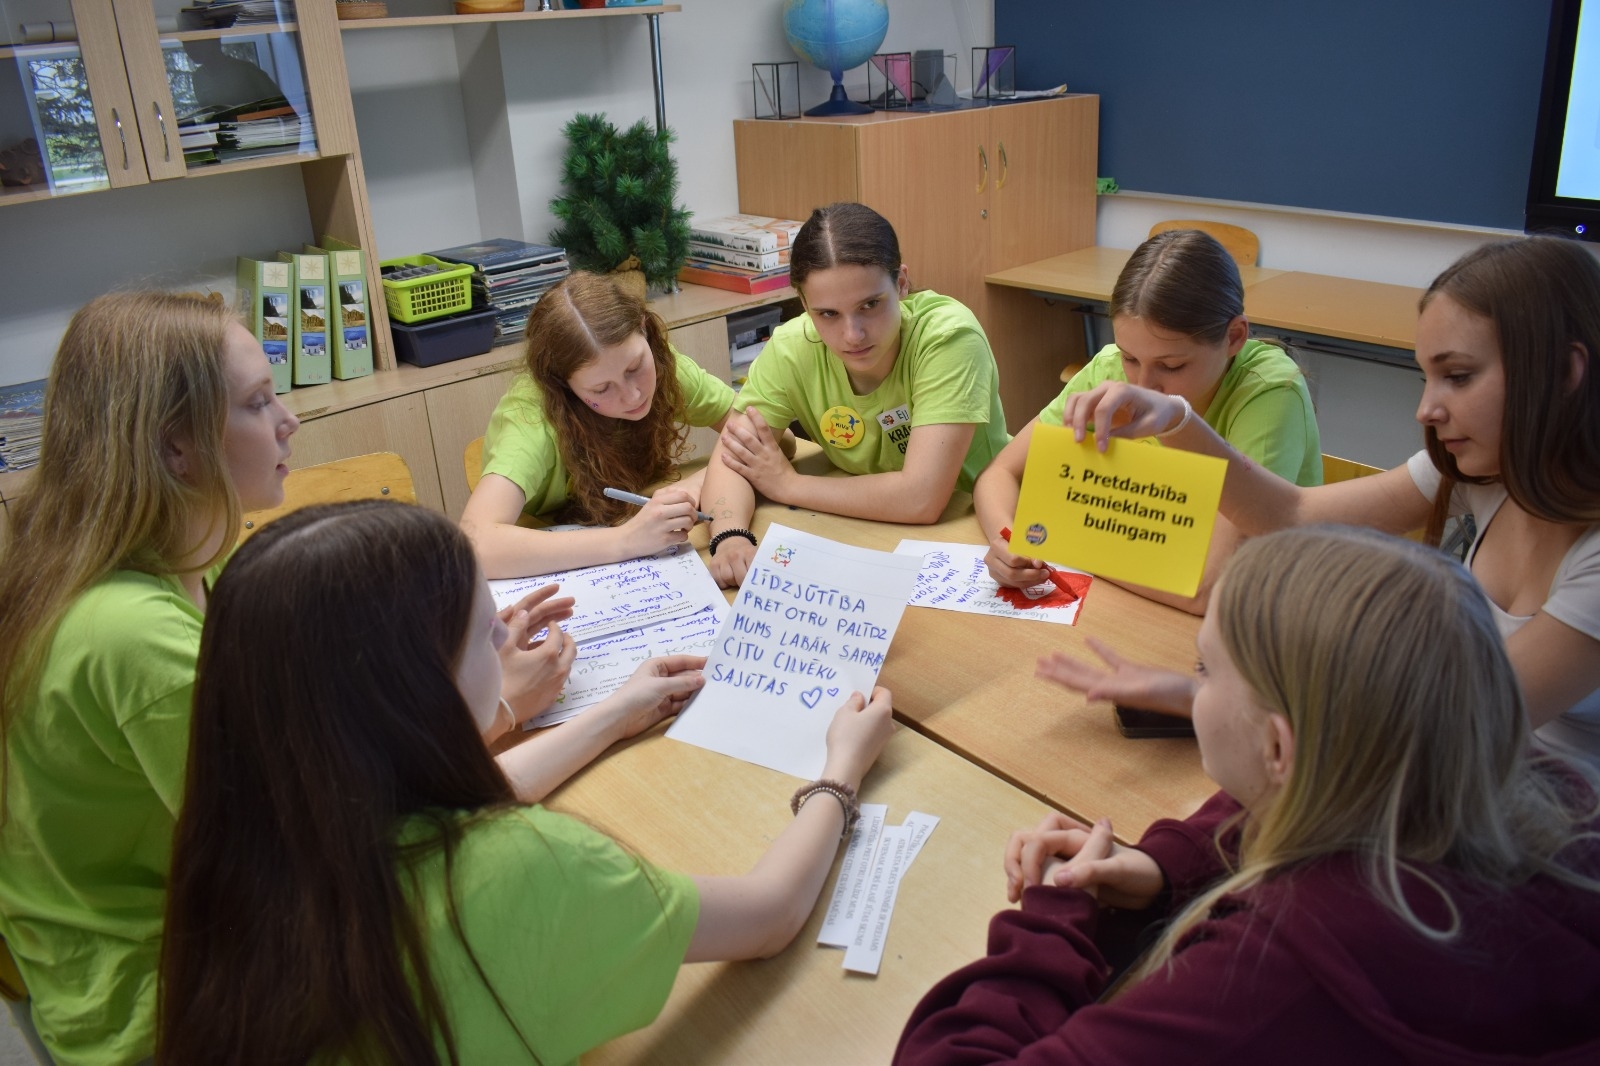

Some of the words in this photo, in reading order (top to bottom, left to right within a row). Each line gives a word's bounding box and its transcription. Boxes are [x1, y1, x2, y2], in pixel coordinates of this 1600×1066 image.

[1059, 464, 1075, 480] 3.
[1082, 468, 1188, 505] Pretdarbība
[1066, 486, 1166, 523] izsmieklam
[1171, 512, 1195, 529] un
[1083, 512, 1167, 546] bulingam
[733, 612, 772, 639] MUMS
[779, 630, 831, 656] LABĀK
[743, 590, 780, 613] PRET
[785, 605, 828, 628] OTRU
[837, 618, 889, 641] PALĪDZ
[710, 663, 789, 696] SAJŪTAS
[723, 635, 764, 662] CITU
[773, 651, 838, 681] CILVĒKU
